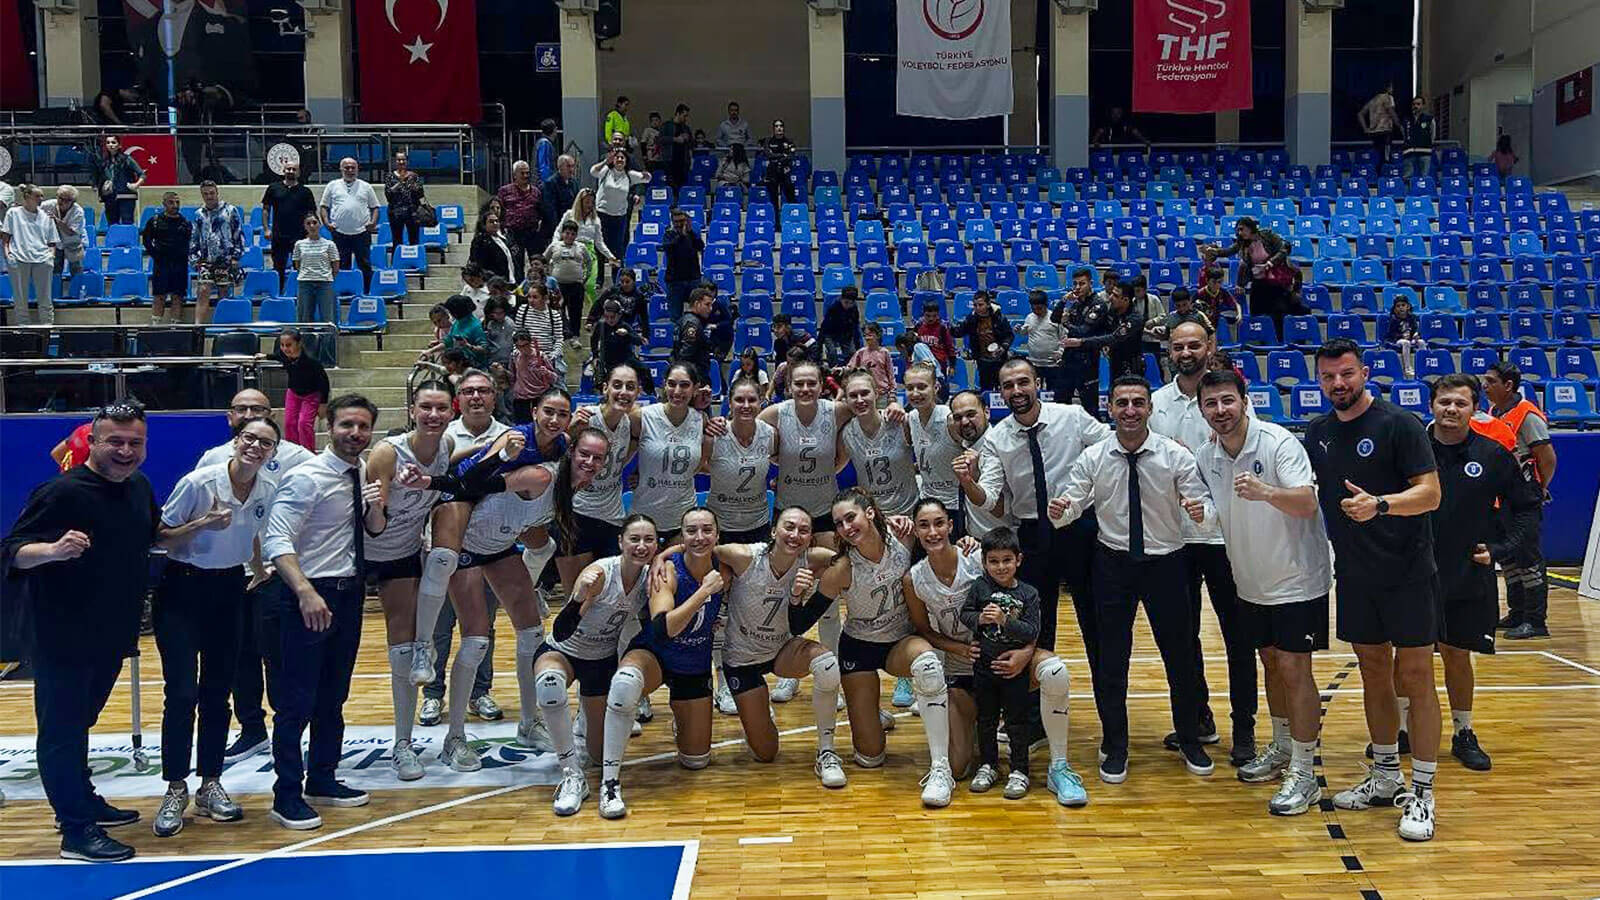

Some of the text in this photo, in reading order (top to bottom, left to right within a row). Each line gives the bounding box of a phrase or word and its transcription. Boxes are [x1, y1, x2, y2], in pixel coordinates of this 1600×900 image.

[936, 50, 973, 60] TÜRKİYE
[1157, 31, 1230, 61] THF
[902, 57, 1007, 70] VOLEYBOL FEDERASYONU
[1156, 72, 1217, 82] Federasyonu
[1157, 63, 1192, 73] Türkiye
[662, 445, 691, 475] 18
[799, 446, 817, 473] 5
[864, 456, 892, 485] 13
[736, 466, 756, 493] 2
[599, 610, 629, 635] 9
[762, 597, 784, 626] 7
